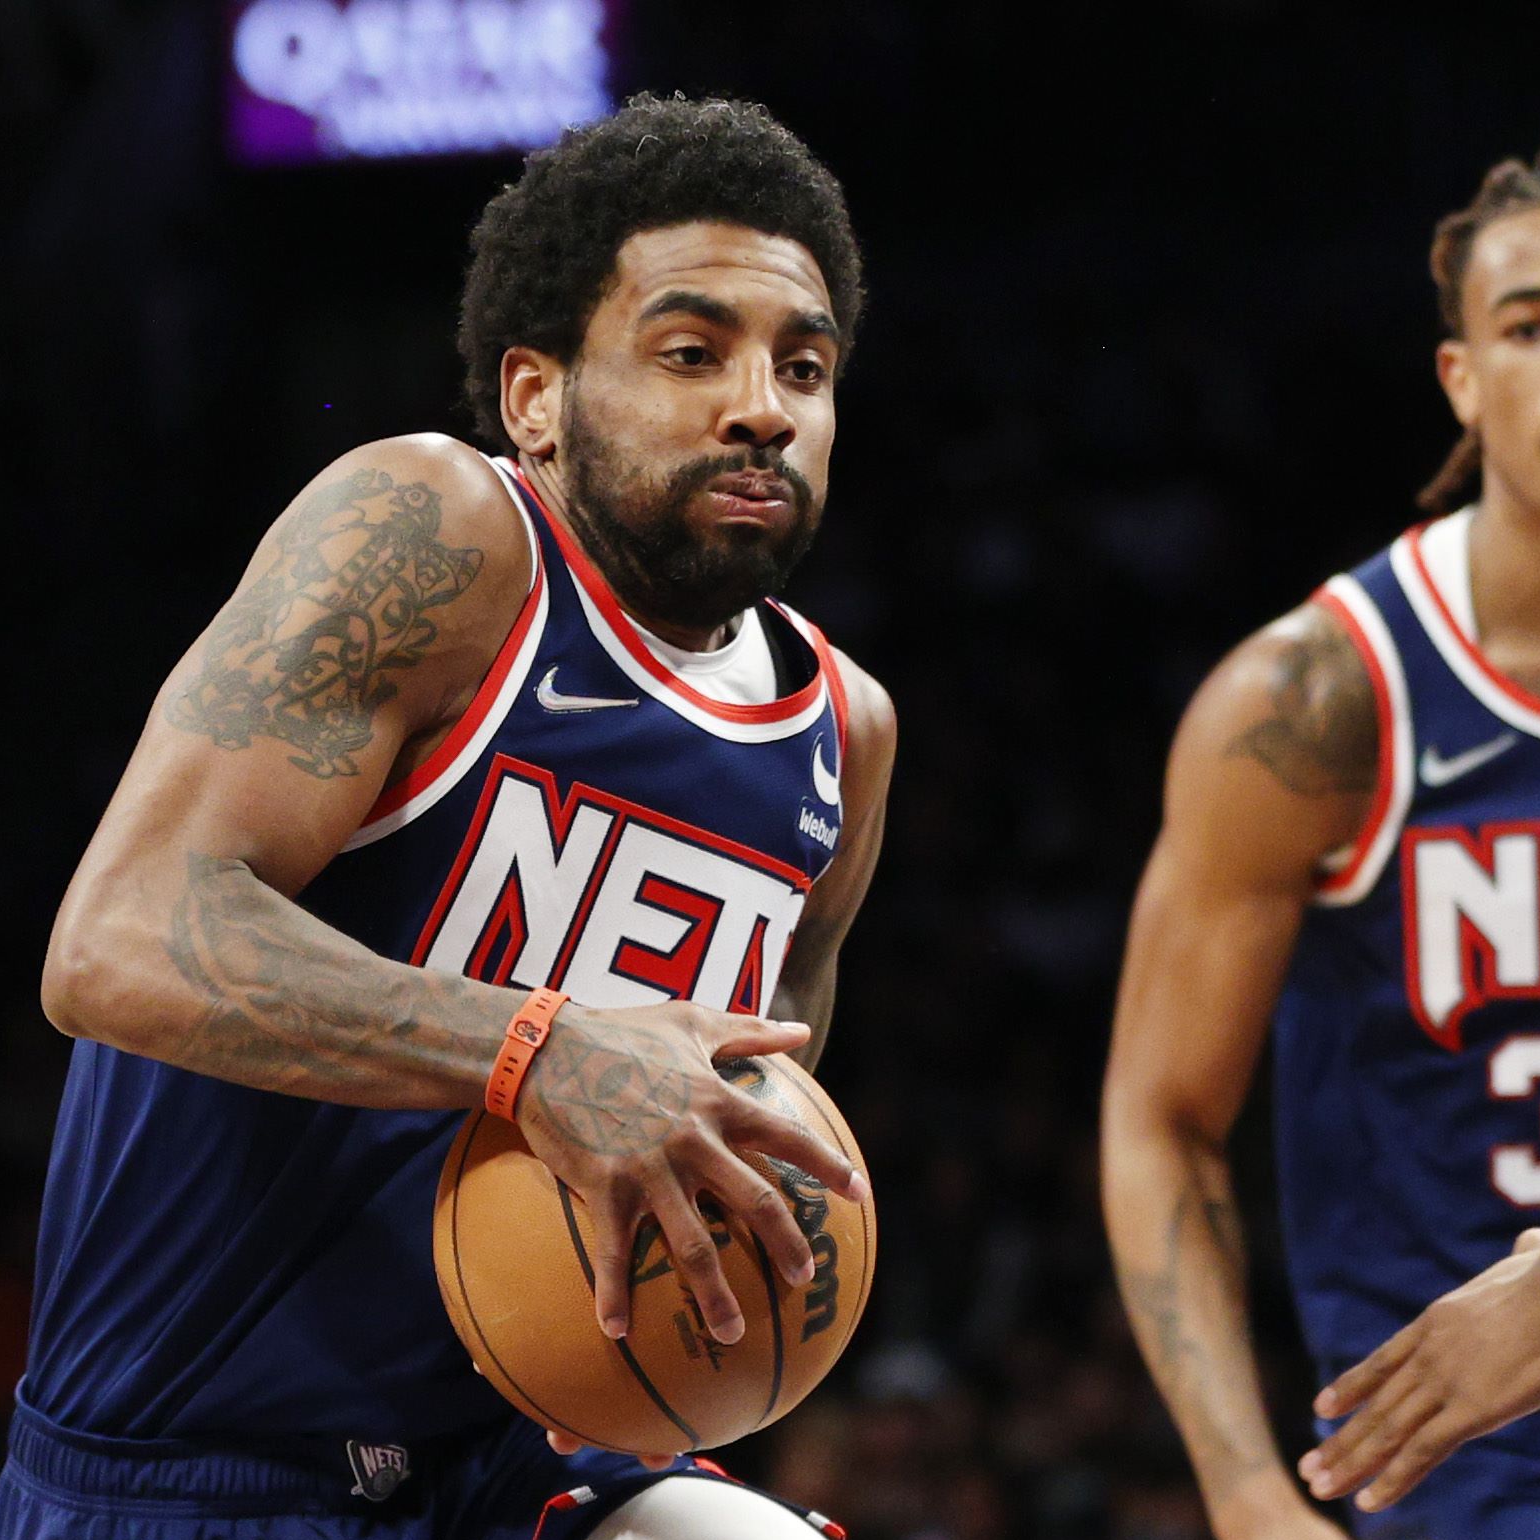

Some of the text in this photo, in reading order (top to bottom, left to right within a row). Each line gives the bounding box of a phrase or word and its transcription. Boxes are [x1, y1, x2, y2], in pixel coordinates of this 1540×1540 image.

[798, 806, 839, 851] Webull
[414, 762, 809, 1018] NET
[359, 1445, 403, 1479] NETS
